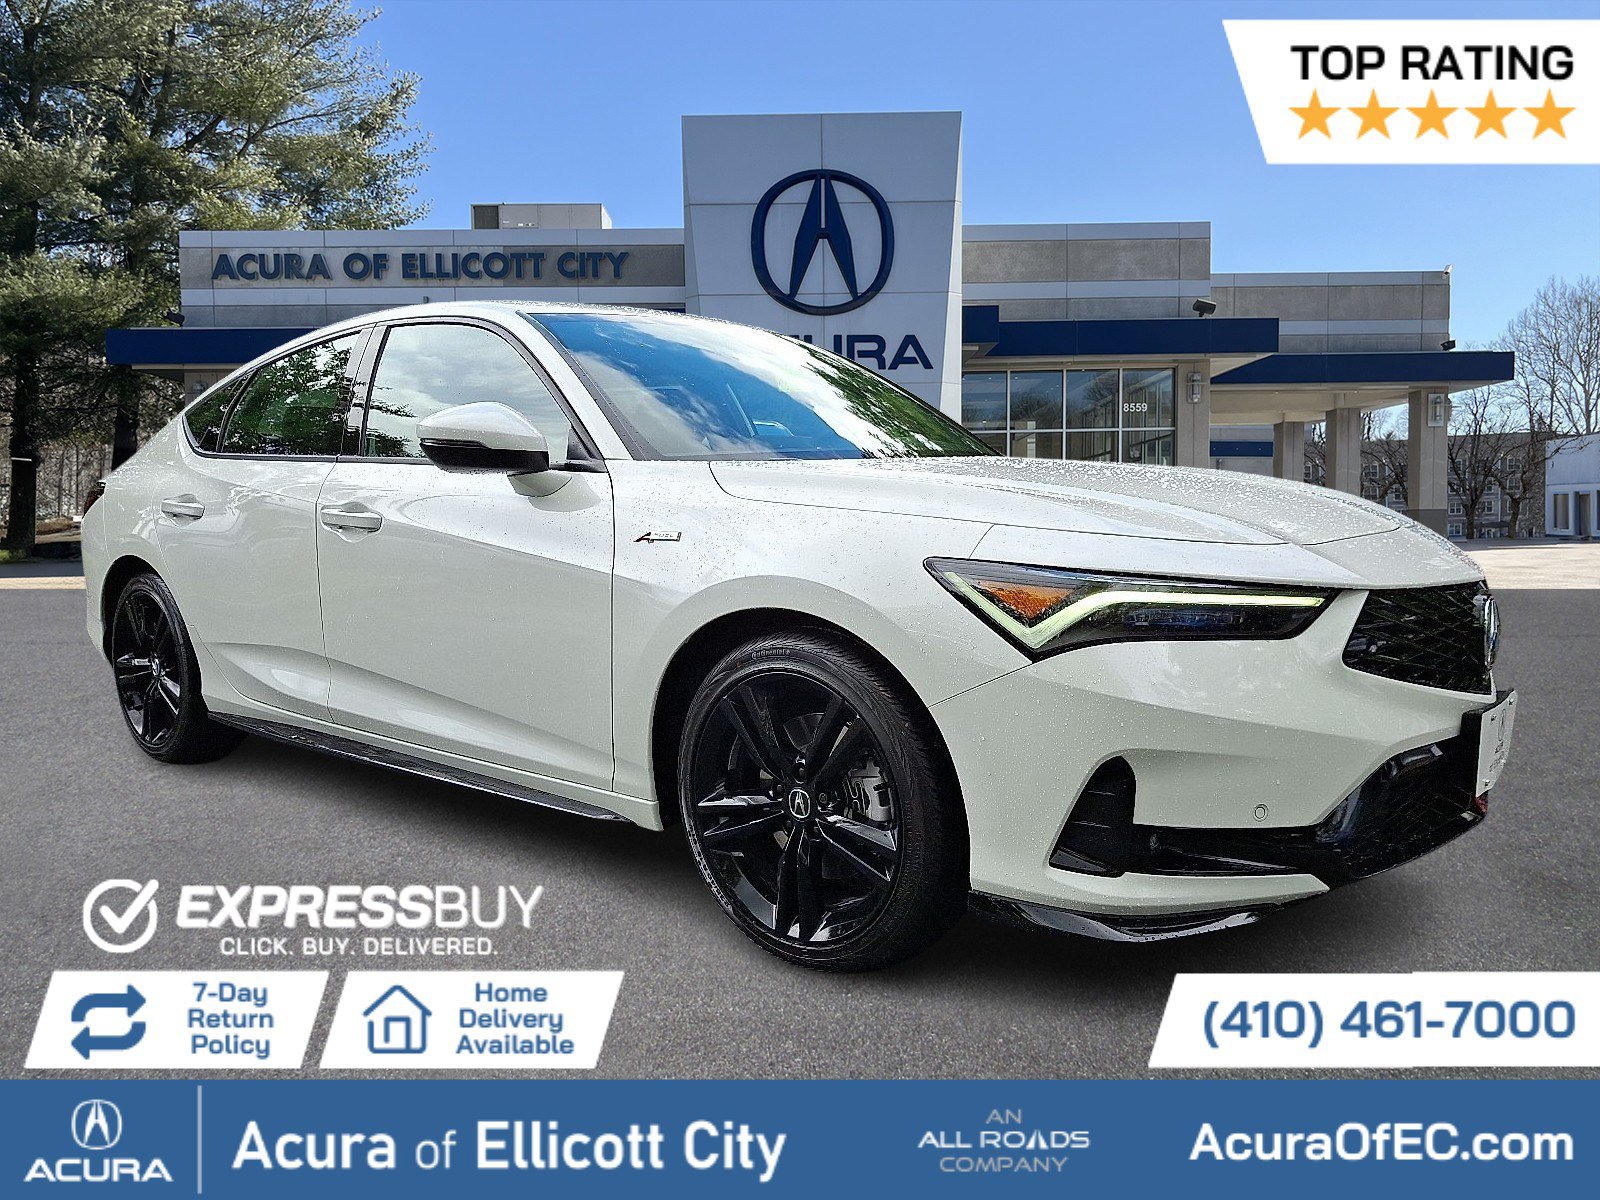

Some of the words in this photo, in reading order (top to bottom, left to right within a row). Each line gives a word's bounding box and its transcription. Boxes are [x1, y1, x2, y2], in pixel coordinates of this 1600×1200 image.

[212, 252, 332, 280] ACURA
[342, 252, 390, 280] OF
[401, 251, 548, 280] ELLICOTT
[556, 251, 630, 279] CITY
[1123, 402, 1148, 412] 8559
